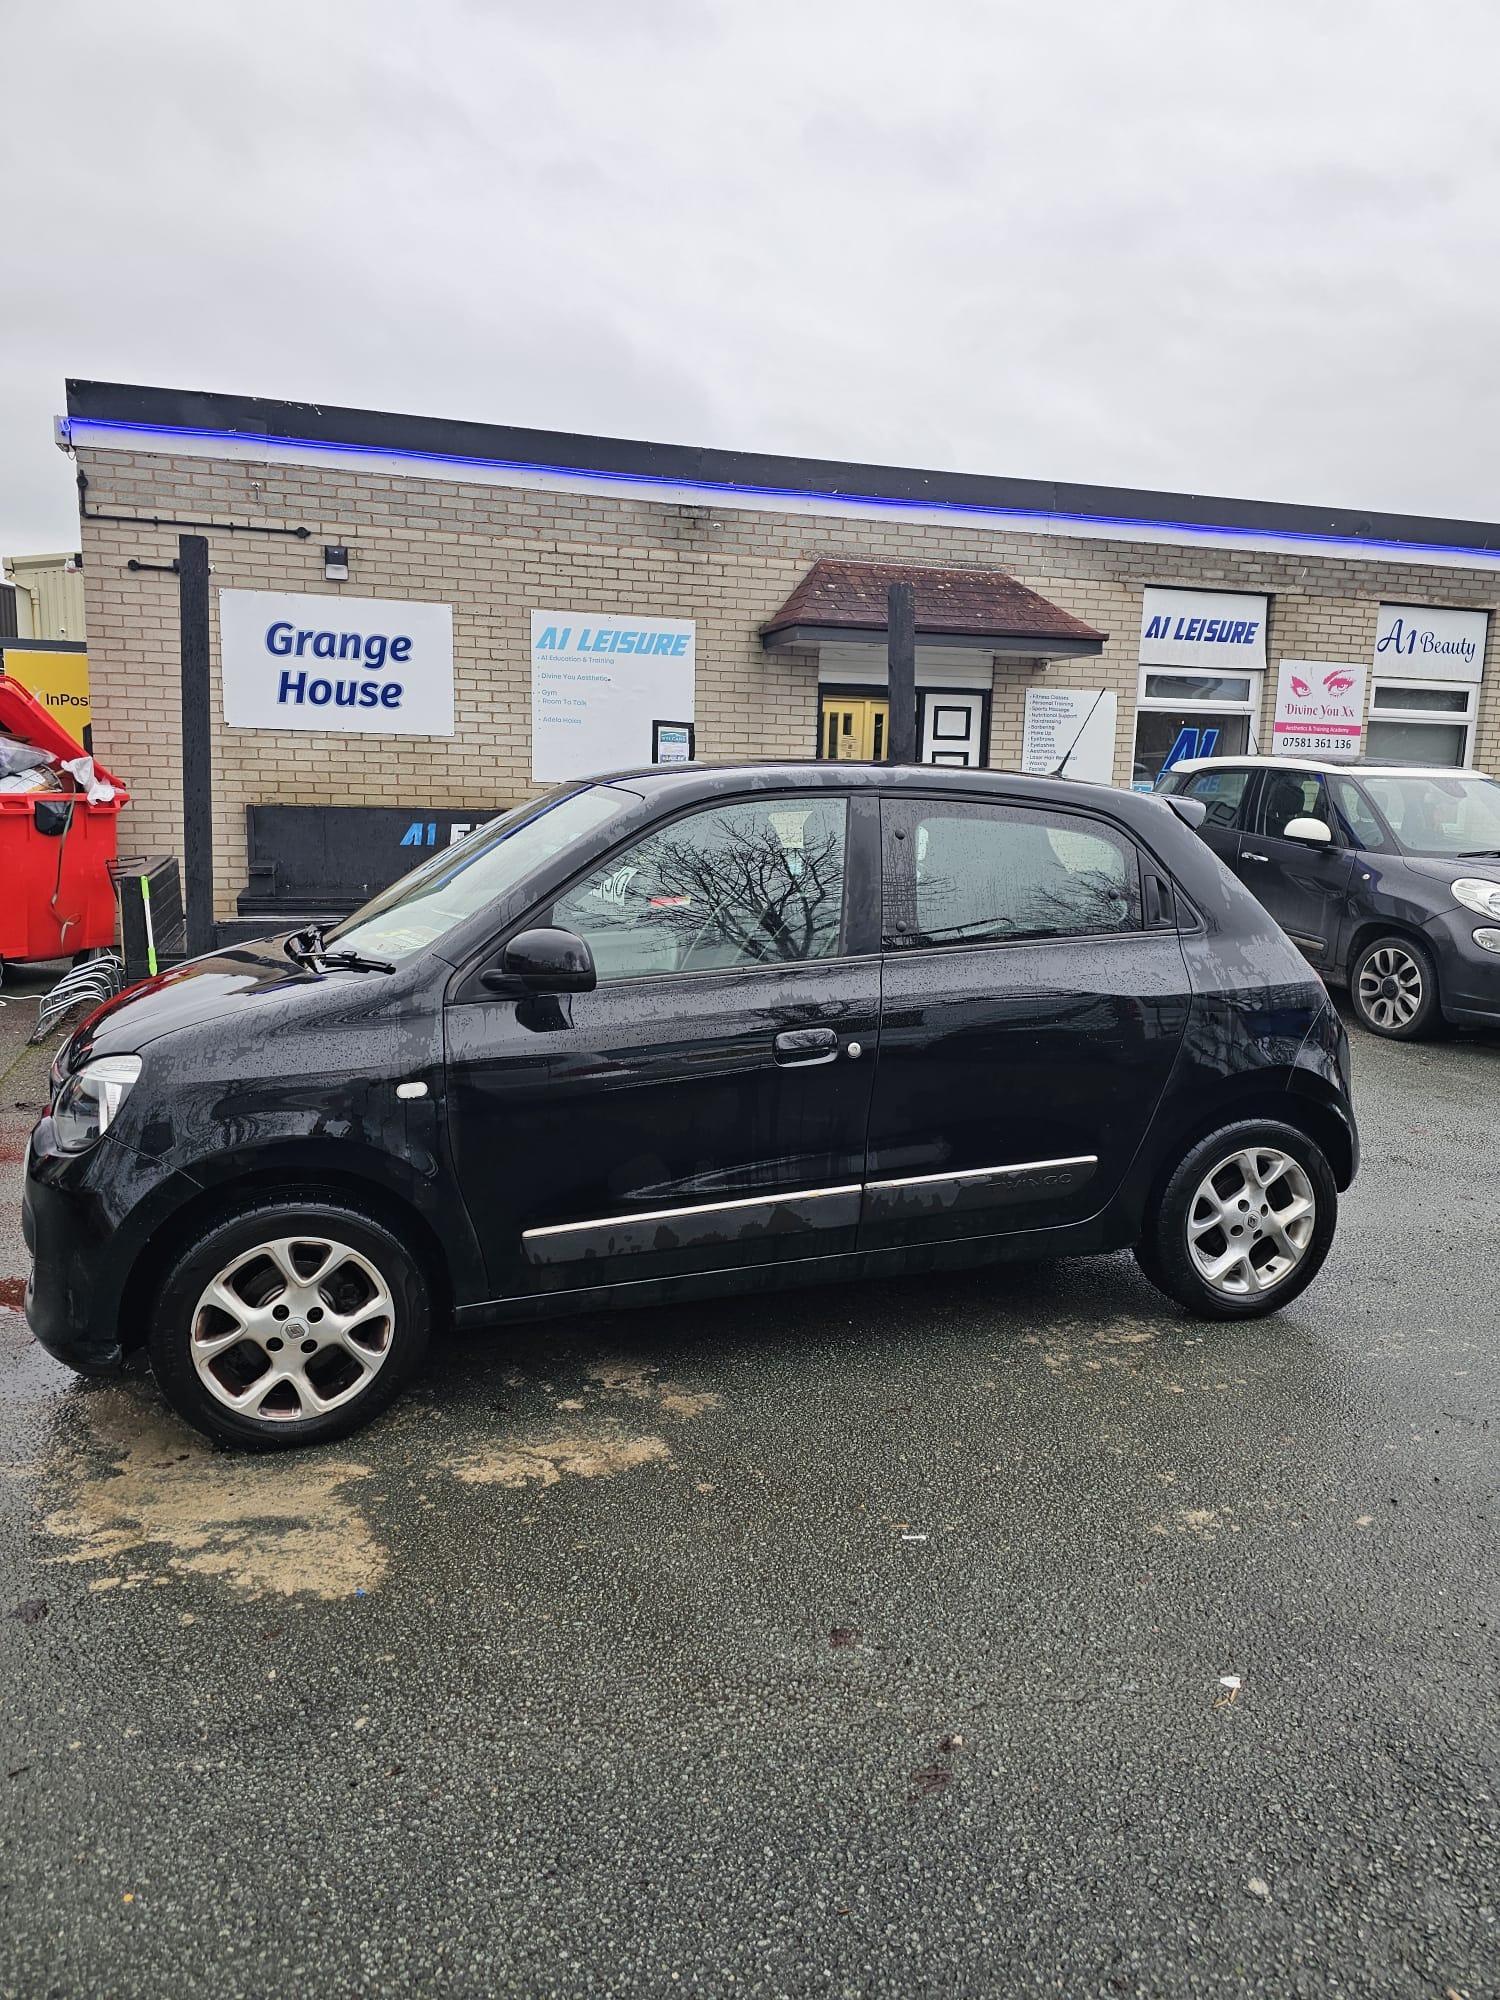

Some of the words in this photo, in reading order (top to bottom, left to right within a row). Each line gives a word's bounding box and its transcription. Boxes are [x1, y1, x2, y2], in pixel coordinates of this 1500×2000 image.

[577, 629, 691, 656] LEISURE
[1174, 618, 1259, 644] LEISURE
[265, 621, 413, 670] Grange
[1421, 631, 1476, 663] Beauty
[46, 693, 90, 706] InPos
[277, 670, 404, 709] House
[1285, 704, 1318, 716] Divine
[1319, 705, 1339, 719] You
[1282, 737, 1311, 748] 07581
[1314, 738, 1331, 749] 361
[1334, 739, 1352, 749] 136
